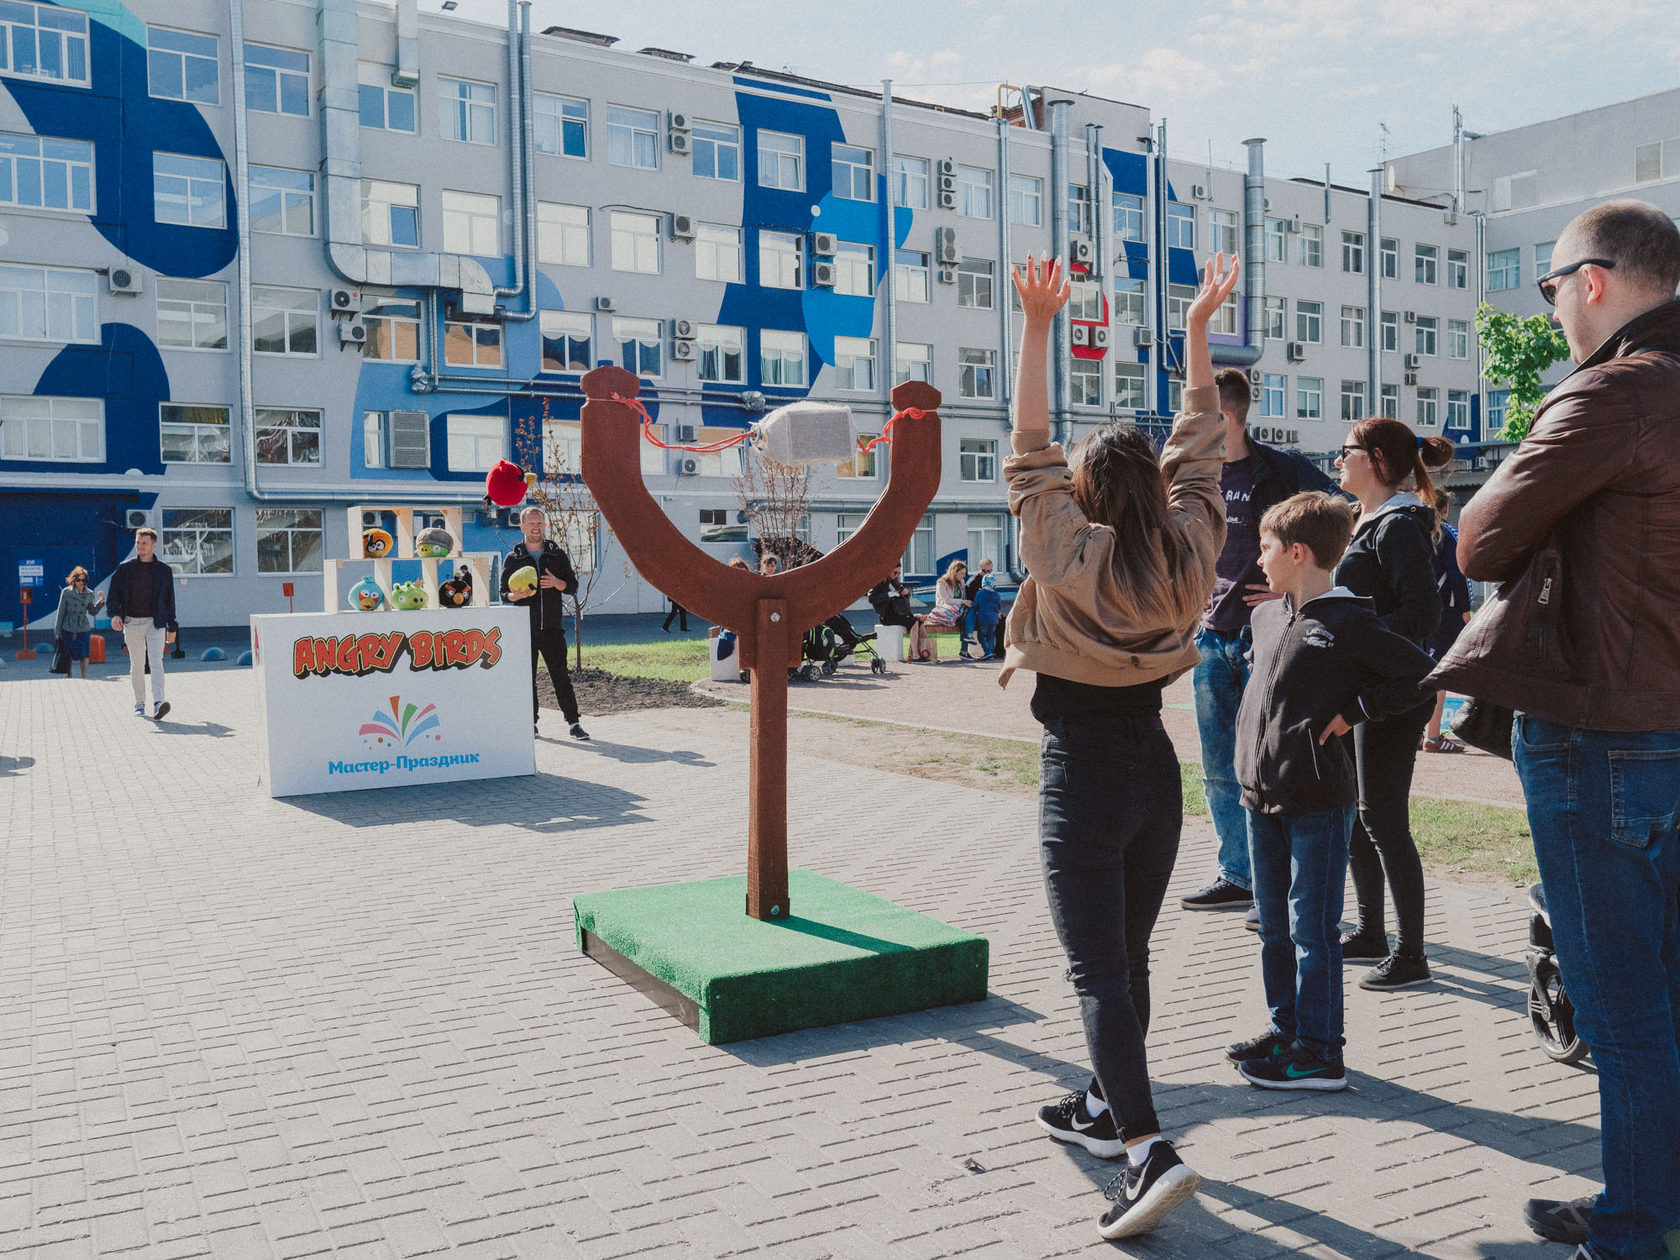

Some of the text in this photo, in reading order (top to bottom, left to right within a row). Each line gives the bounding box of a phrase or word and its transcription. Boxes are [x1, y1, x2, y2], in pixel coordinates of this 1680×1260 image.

[293, 626, 502, 679] ANGRY BIRDS
[328, 753, 480, 774] Мастер-Праздник
